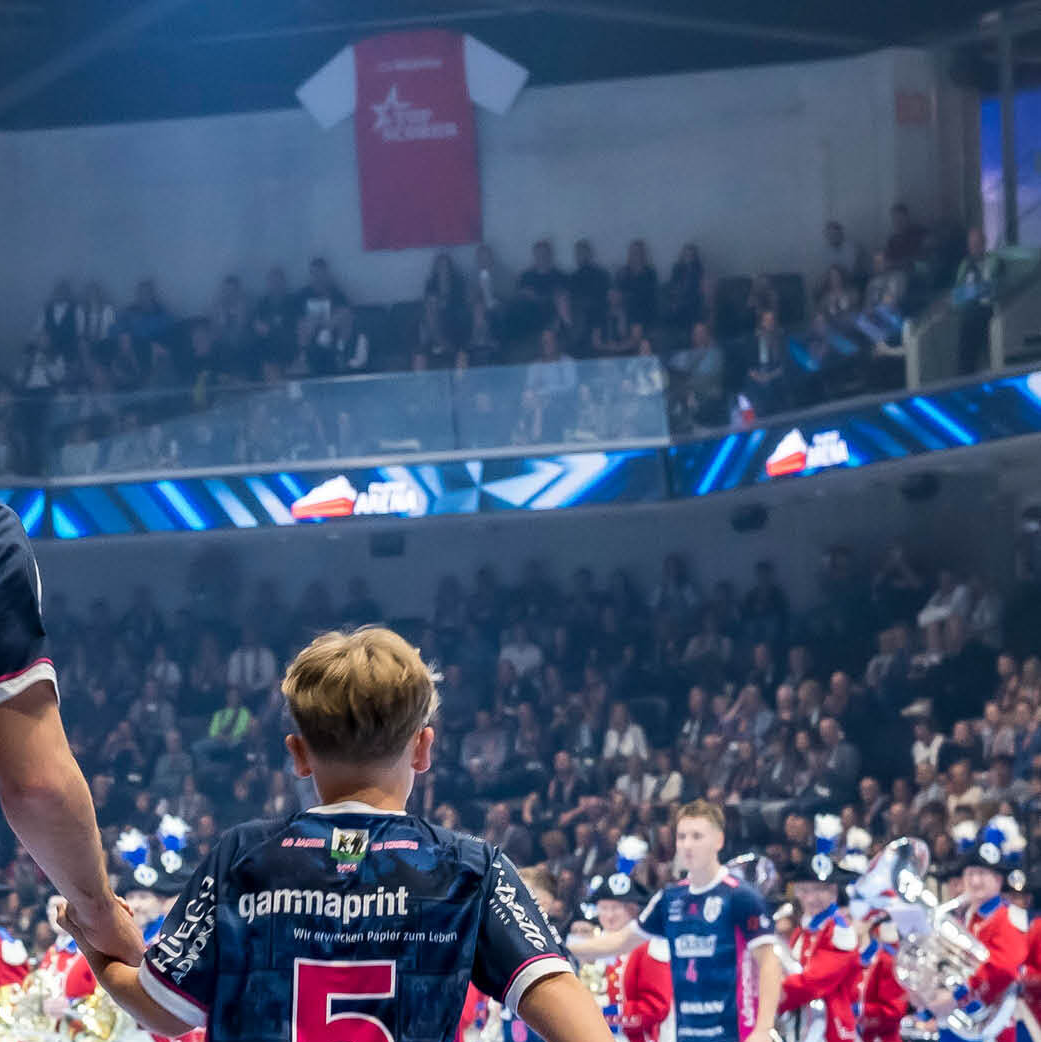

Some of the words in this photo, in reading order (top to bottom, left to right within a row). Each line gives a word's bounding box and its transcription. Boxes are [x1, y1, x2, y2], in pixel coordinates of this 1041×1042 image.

[239, 886, 409, 924] gammaprint
[293, 927, 311, 941] Wir
[403, 931, 426, 942] zum
